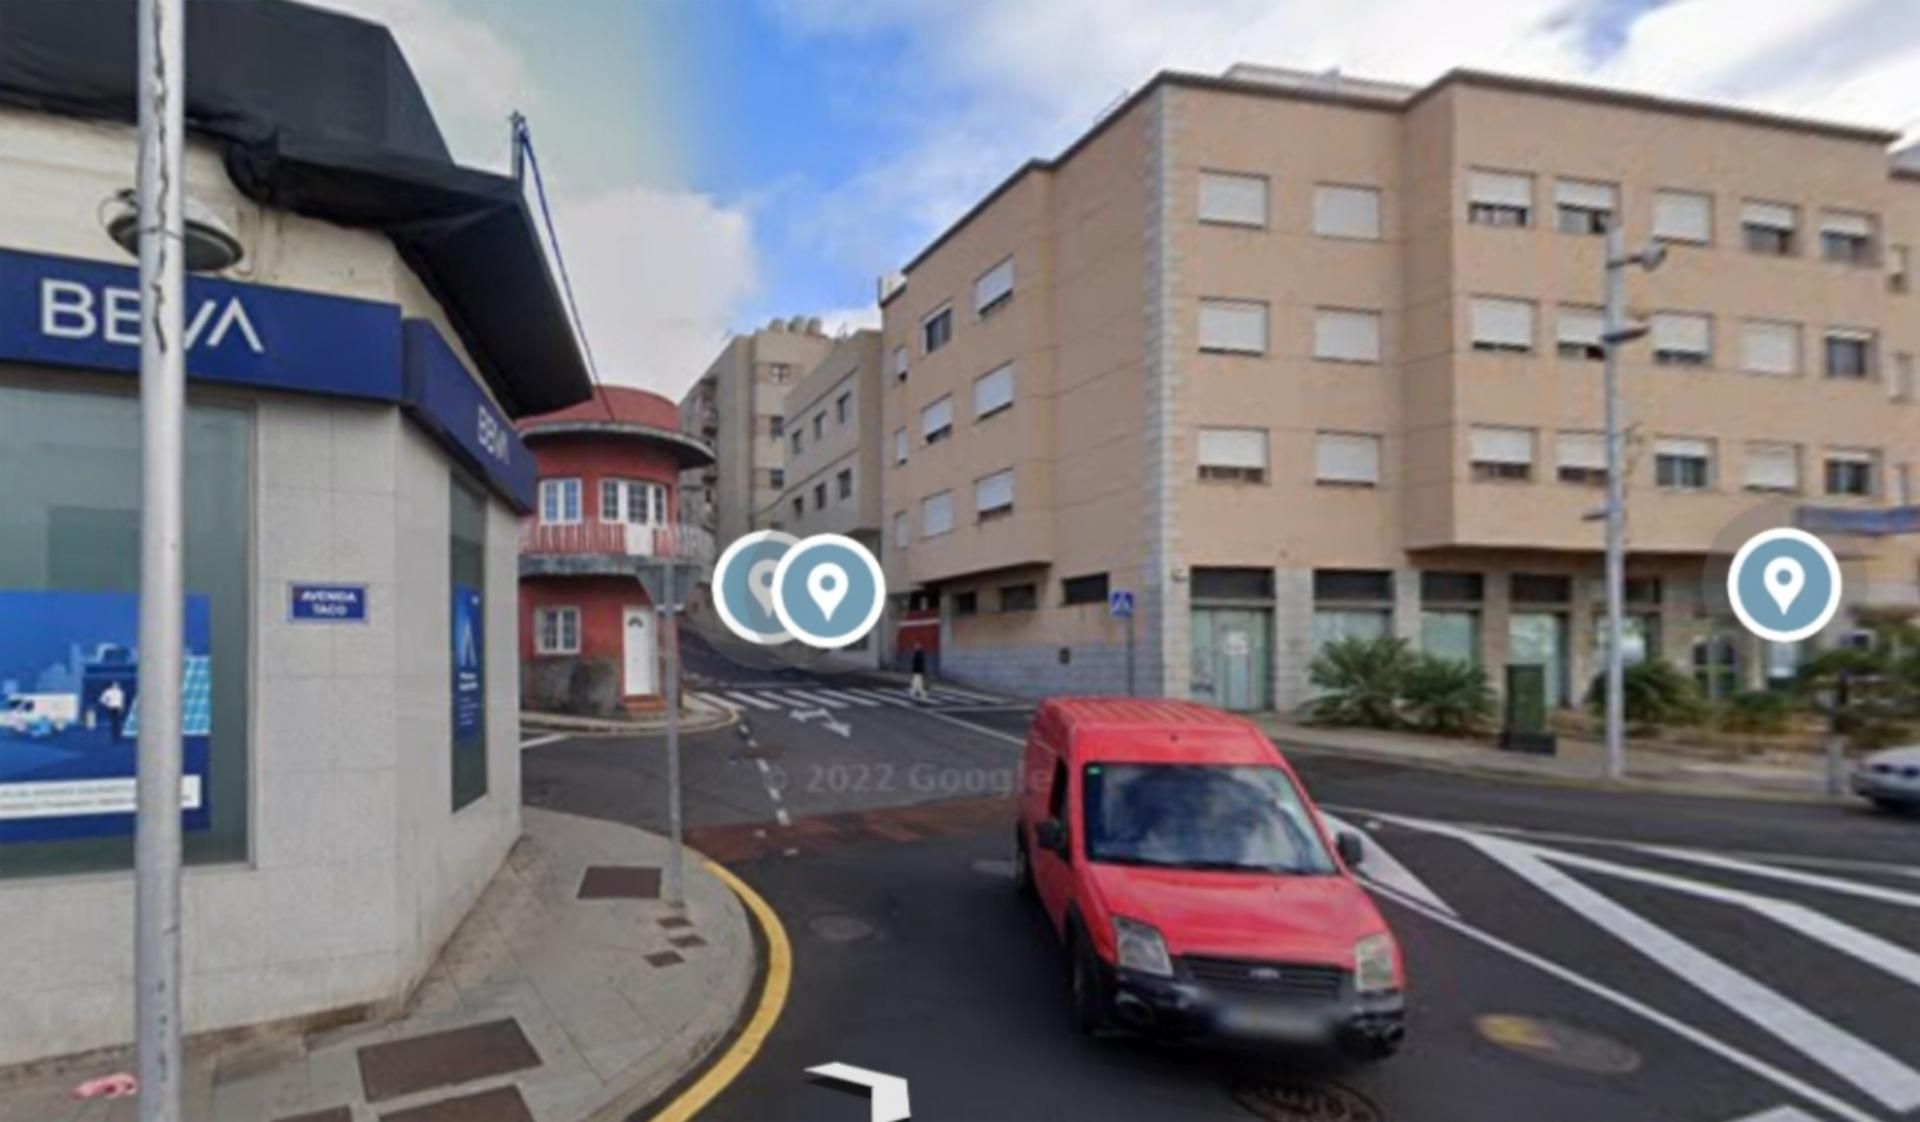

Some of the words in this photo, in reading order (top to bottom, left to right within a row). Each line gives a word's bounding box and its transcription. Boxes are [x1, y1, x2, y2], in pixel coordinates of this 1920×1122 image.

[478, 404, 510, 465] BBVA
[301, 589, 359, 602] AVENIDA
[312, 603, 348, 616] TACO
